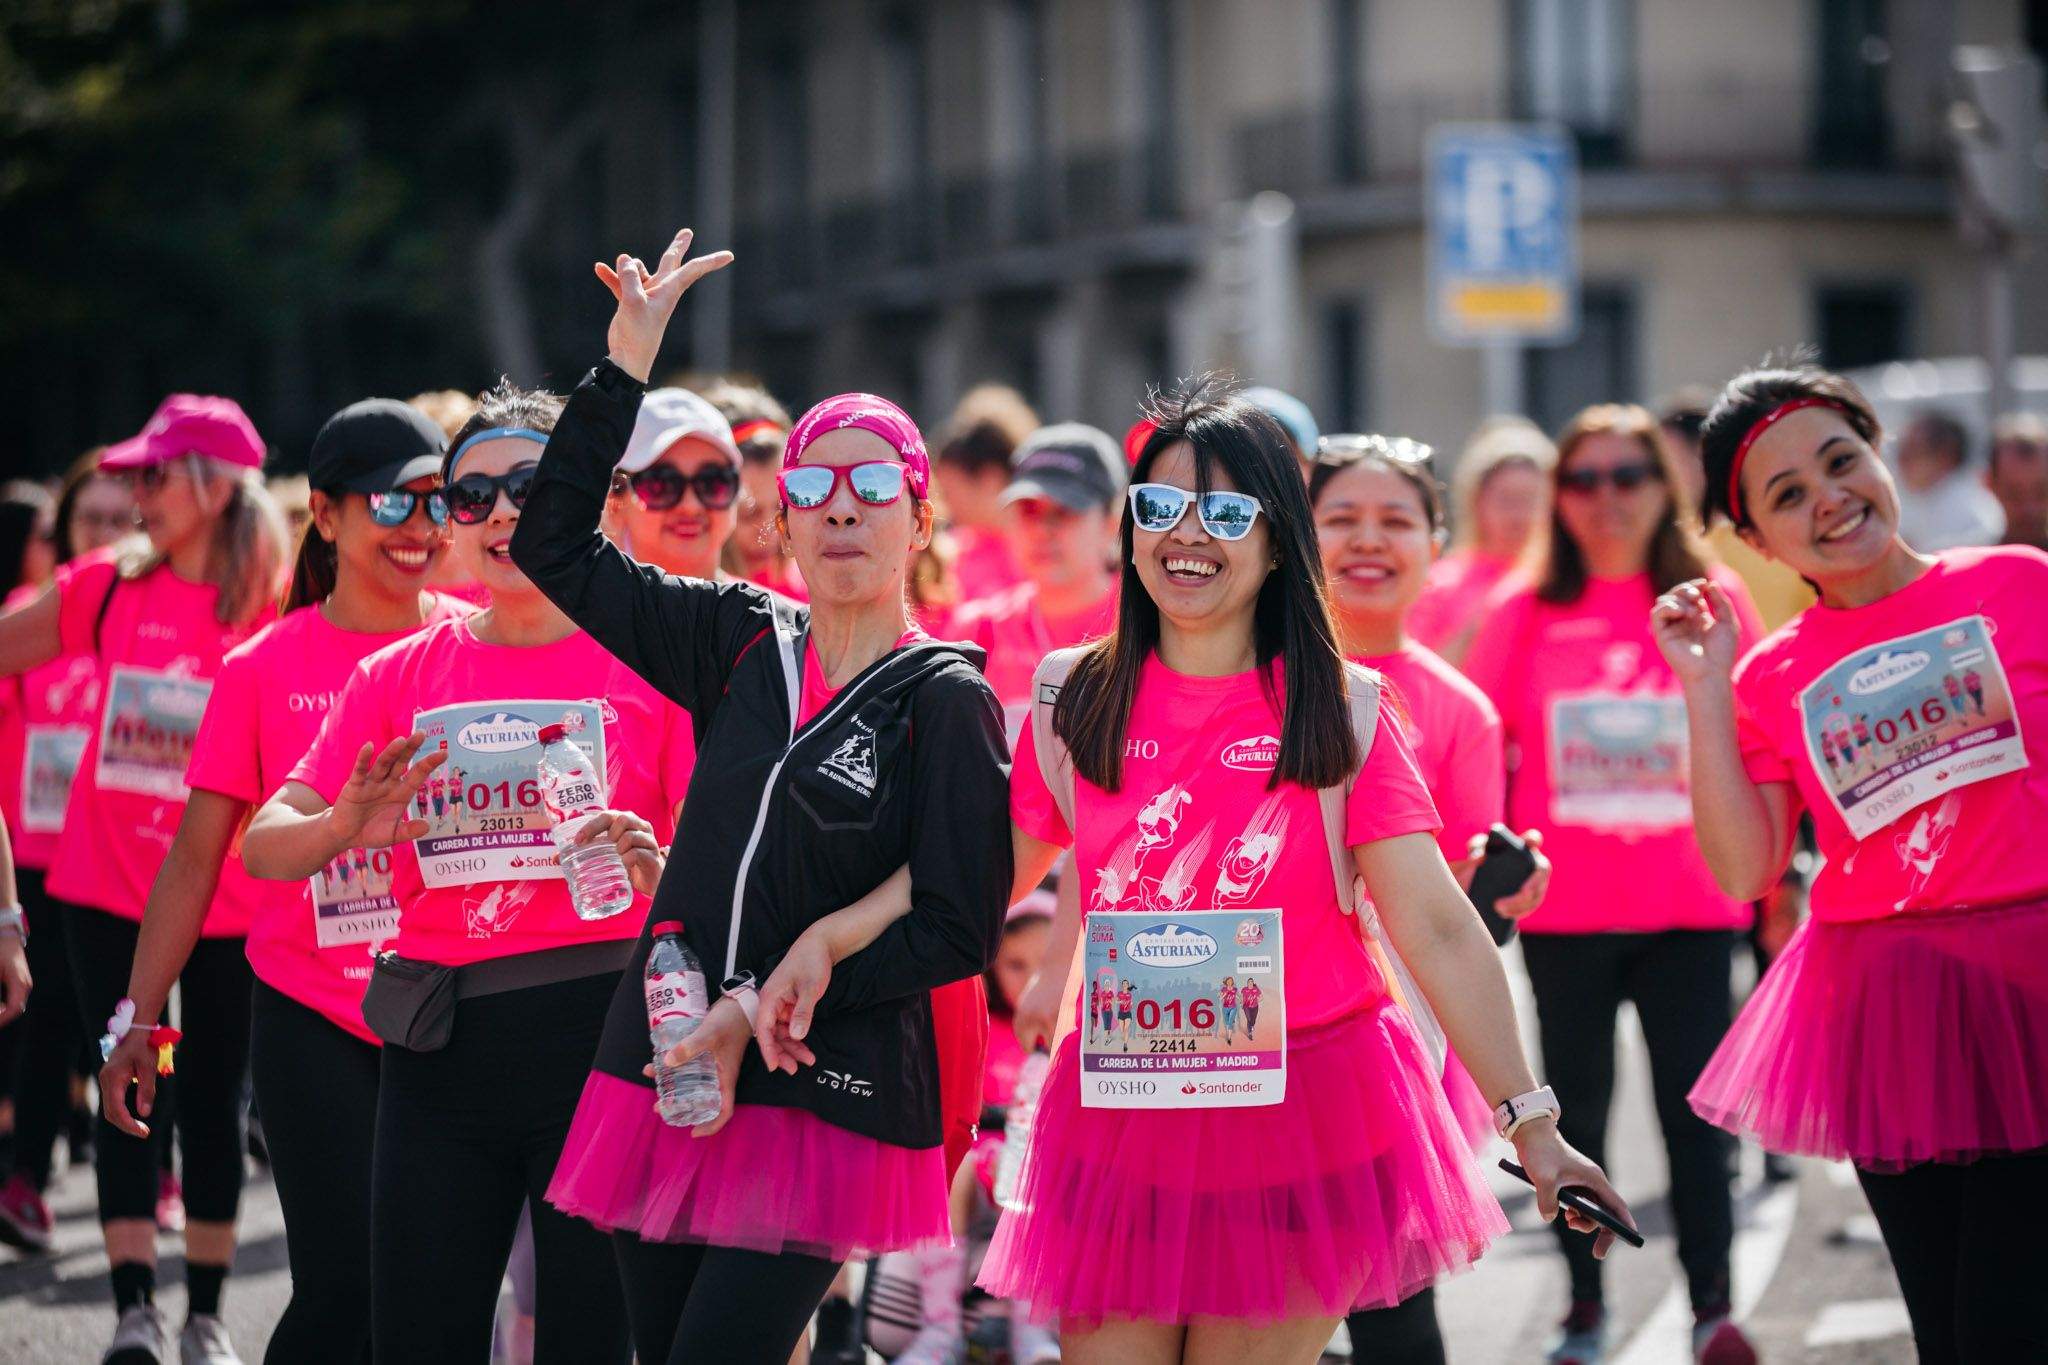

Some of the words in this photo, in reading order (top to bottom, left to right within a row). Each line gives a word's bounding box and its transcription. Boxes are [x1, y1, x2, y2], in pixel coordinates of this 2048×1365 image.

[1874, 698, 1947, 744] 016
[463, 730, 538, 745] ASTURIANA
[828, 771, 857, 789] RUNNING
[467, 780, 541, 811] 016
[556, 783, 592, 800] ZERO
[559, 792, 595, 808] SODIO
[480, 817, 524, 832] 23013
[432, 839, 470, 852] CARRERA
[471, 836, 484, 847] DE
[486, 835, 498, 845] LA
[501, 832, 534, 845] MUJER
[435, 857, 486, 876] OYSHO
[338, 898, 378, 914] CARRERA
[379, 896, 392, 909] DE
[1091, 932, 1115, 943] SUMA
[1240, 923, 1260, 936] 20
[1132, 940, 1212, 957] ASTURIANA
[1136, 999, 1216, 1030] 016
[1149, 1039, 1197, 1053] 22414
[1098, 1057, 1139, 1069] CARRERA
[1141, 1057, 1154, 1068] DE
[1156, 1057, 1169, 1068] LA
[1171, 1056, 1208, 1068] MUJER
[1216, 1055, 1259, 1067] MADRID
[817, 1076, 873, 1097] uglow
[1097, 1079, 1157, 1096] OYSHO
[1199, 1081, 1263, 1094] Santander
